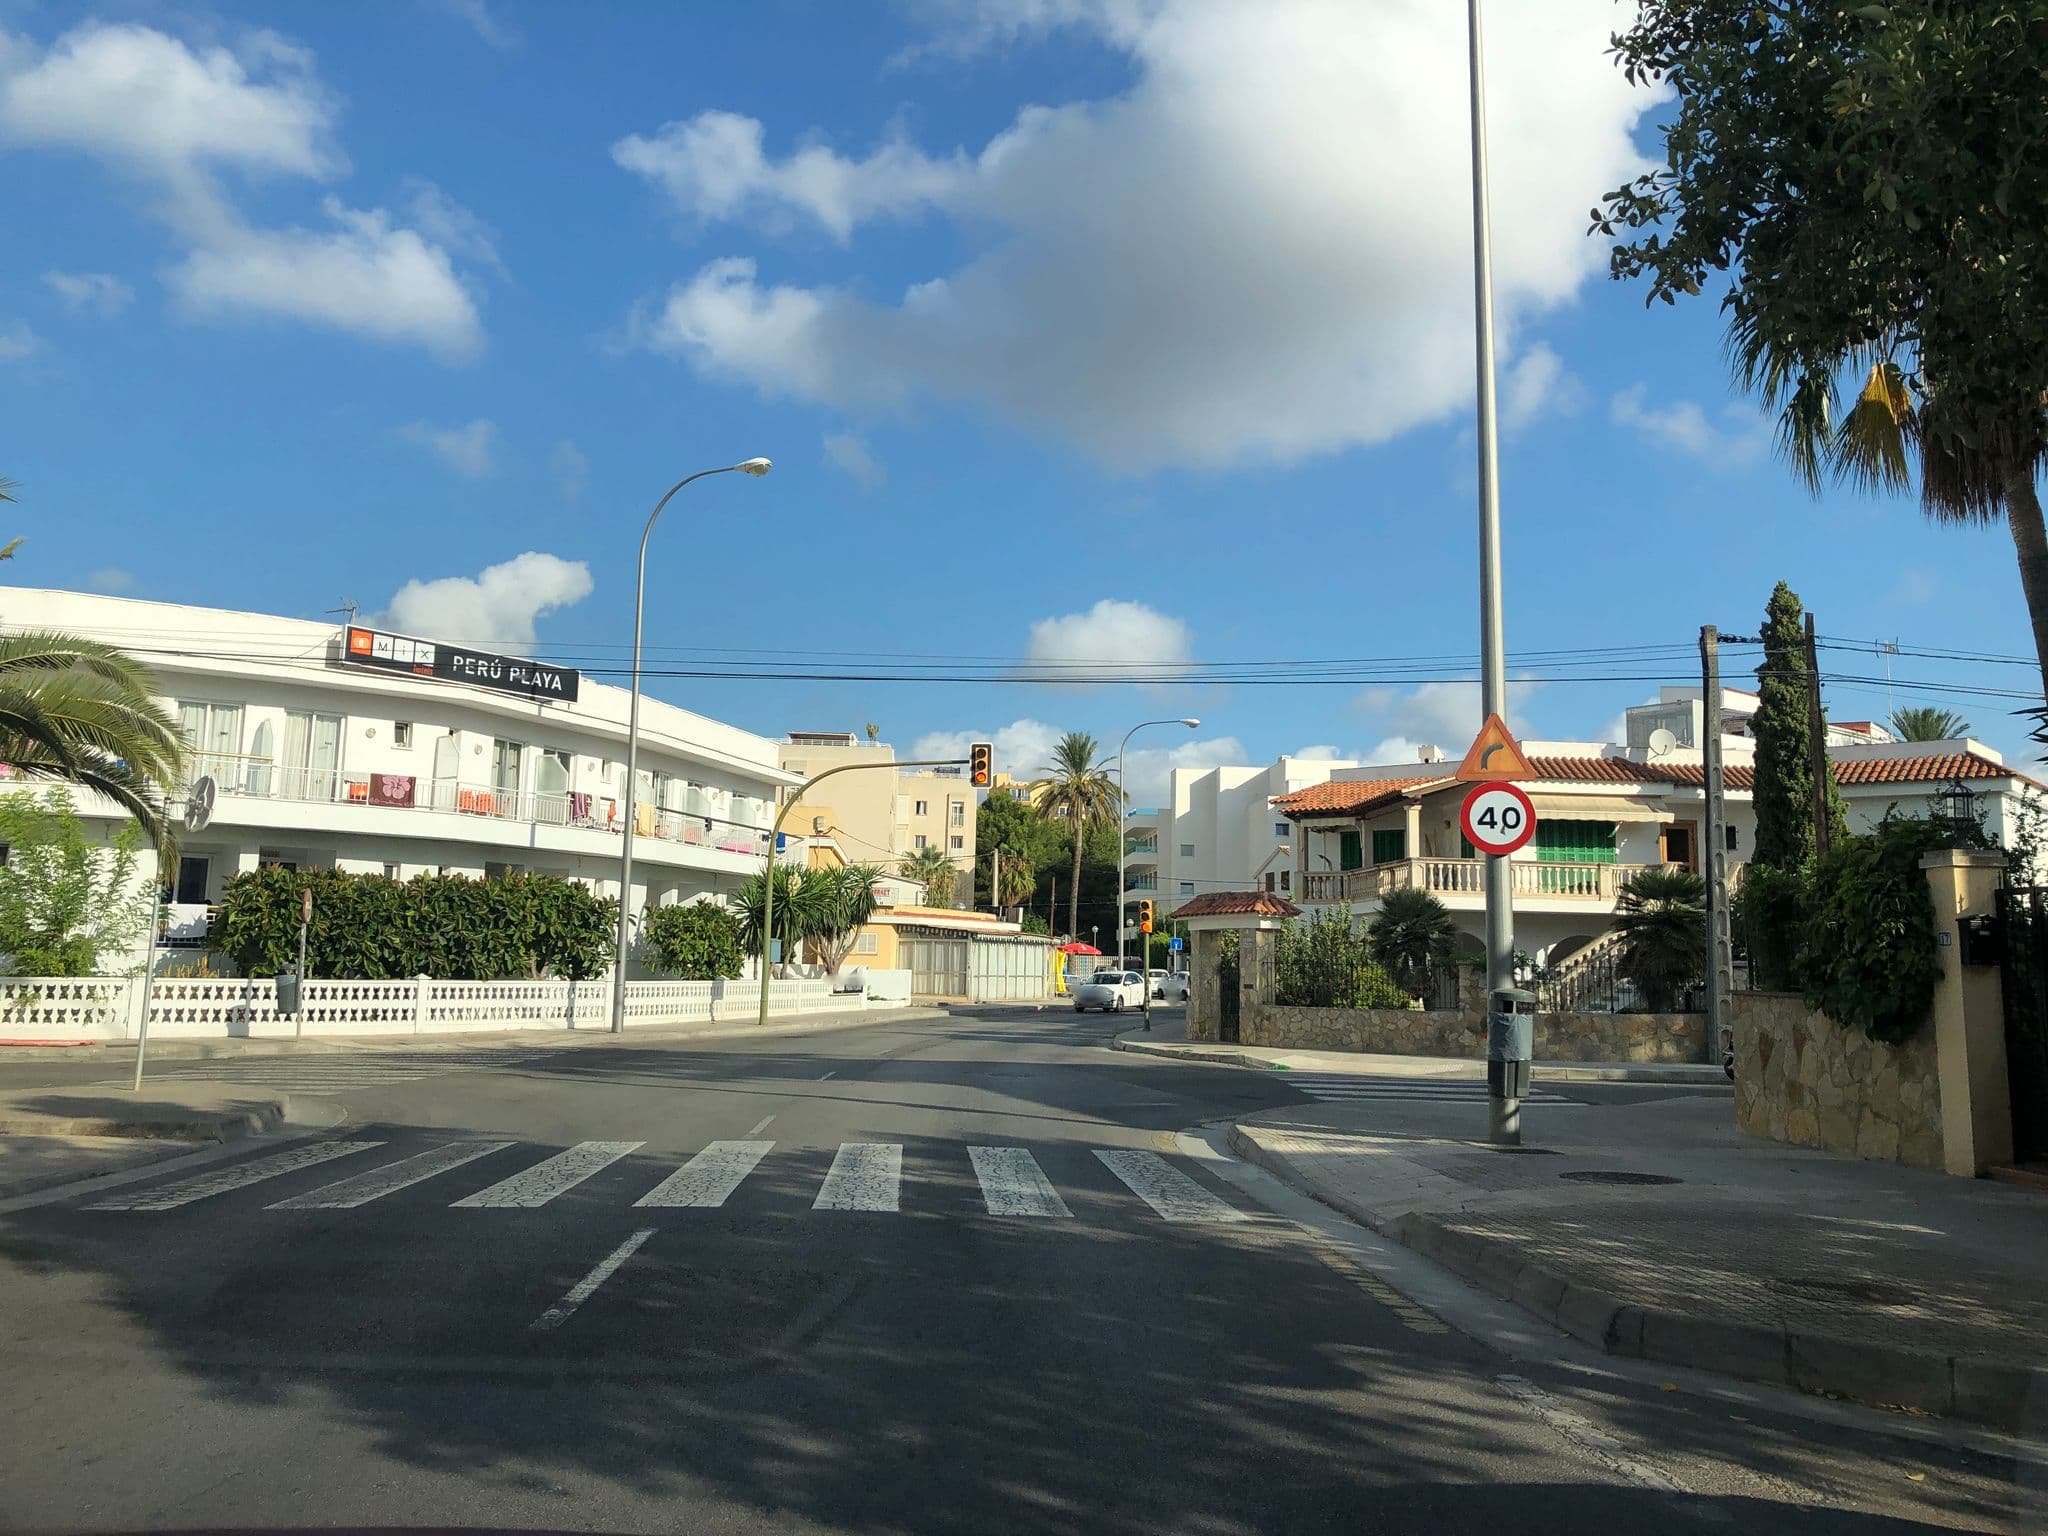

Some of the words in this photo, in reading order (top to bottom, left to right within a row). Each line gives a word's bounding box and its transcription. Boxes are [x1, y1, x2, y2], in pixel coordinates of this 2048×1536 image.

[453, 655, 502, 679] PERÚ
[509, 667, 562, 691] PLAYA
[1477, 806, 1521, 829] 40
